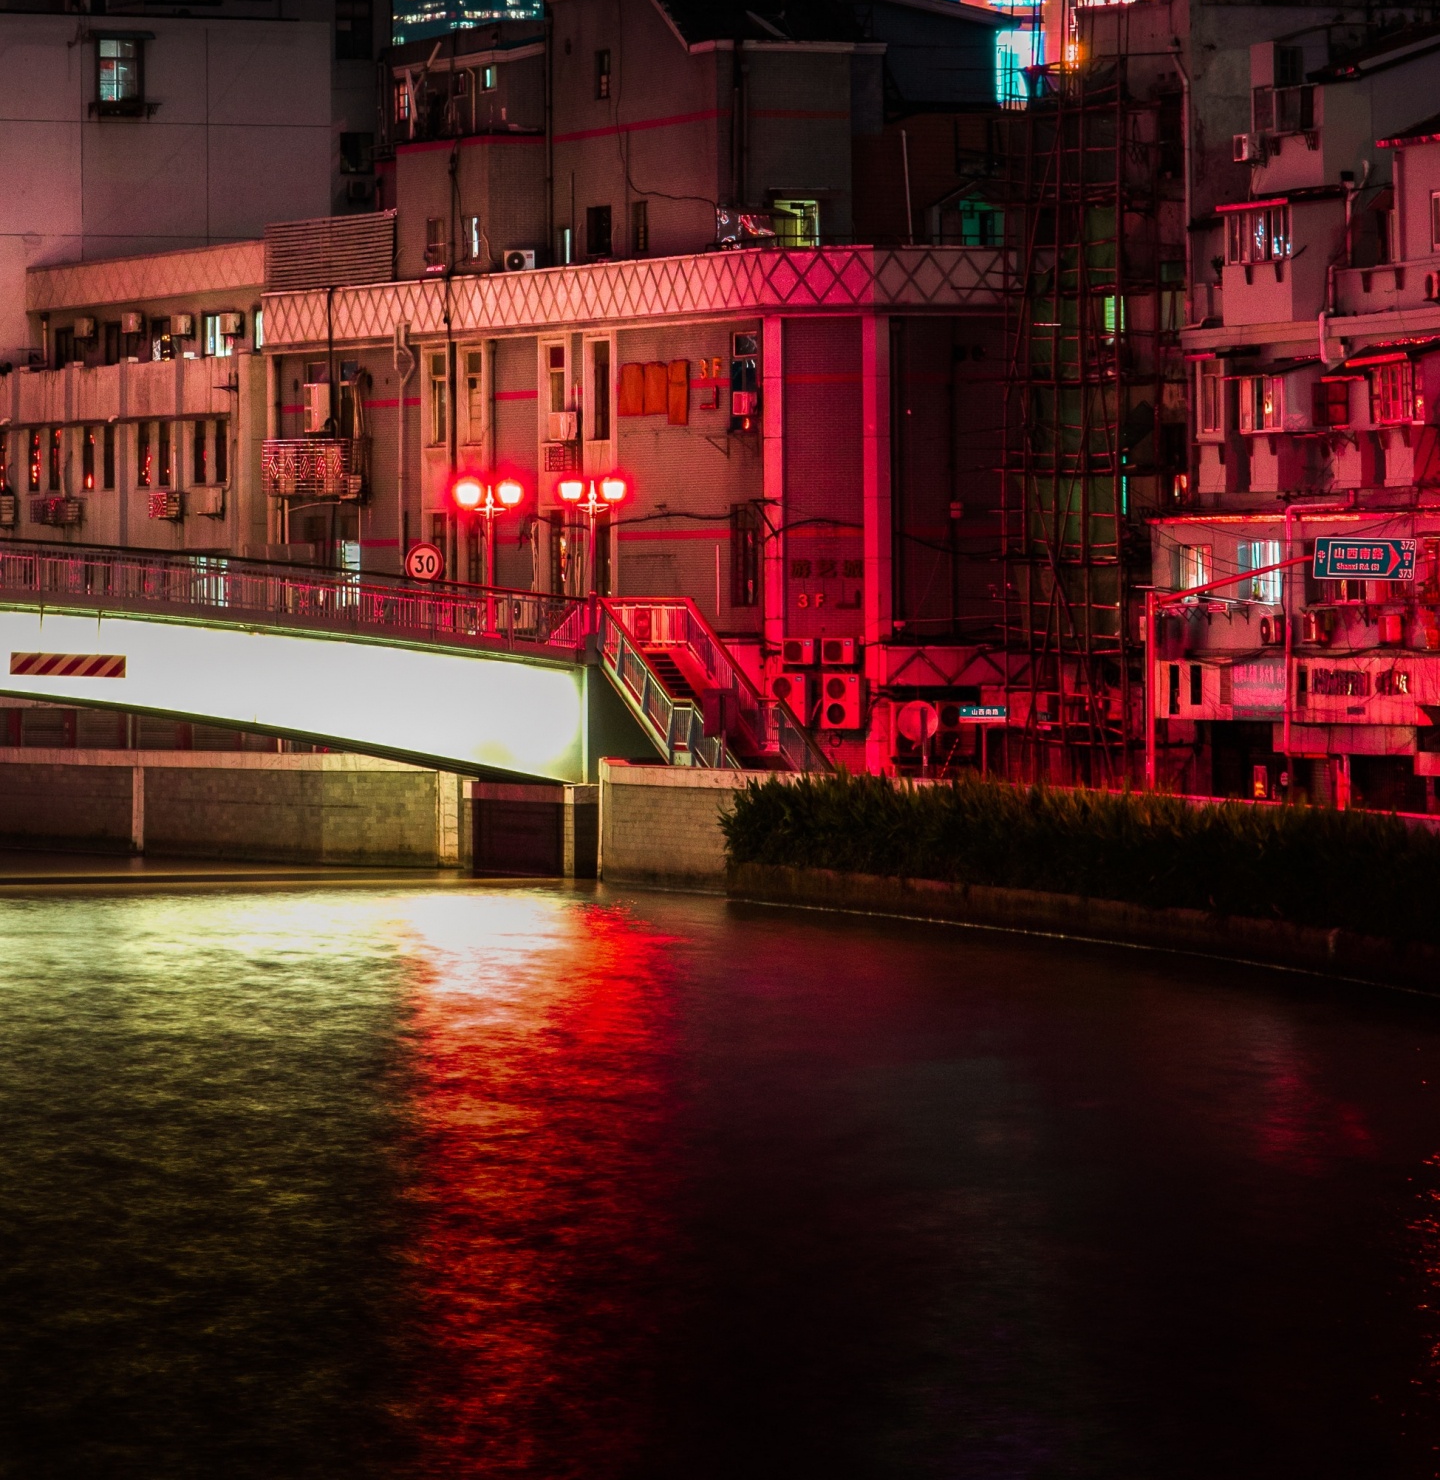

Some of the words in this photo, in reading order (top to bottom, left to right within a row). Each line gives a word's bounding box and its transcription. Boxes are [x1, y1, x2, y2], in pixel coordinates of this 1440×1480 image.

[700, 357, 721, 379] 3F
[1401, 541, 1414, 550] 372
[1317, 550, 1326, 559] 北
[1334, 547, 1384, 560] 山西南路
[414, 555, 436, 574] 30
[1398, 569, 1412, 578] 373
[798, 593, 824, 608] 3F
